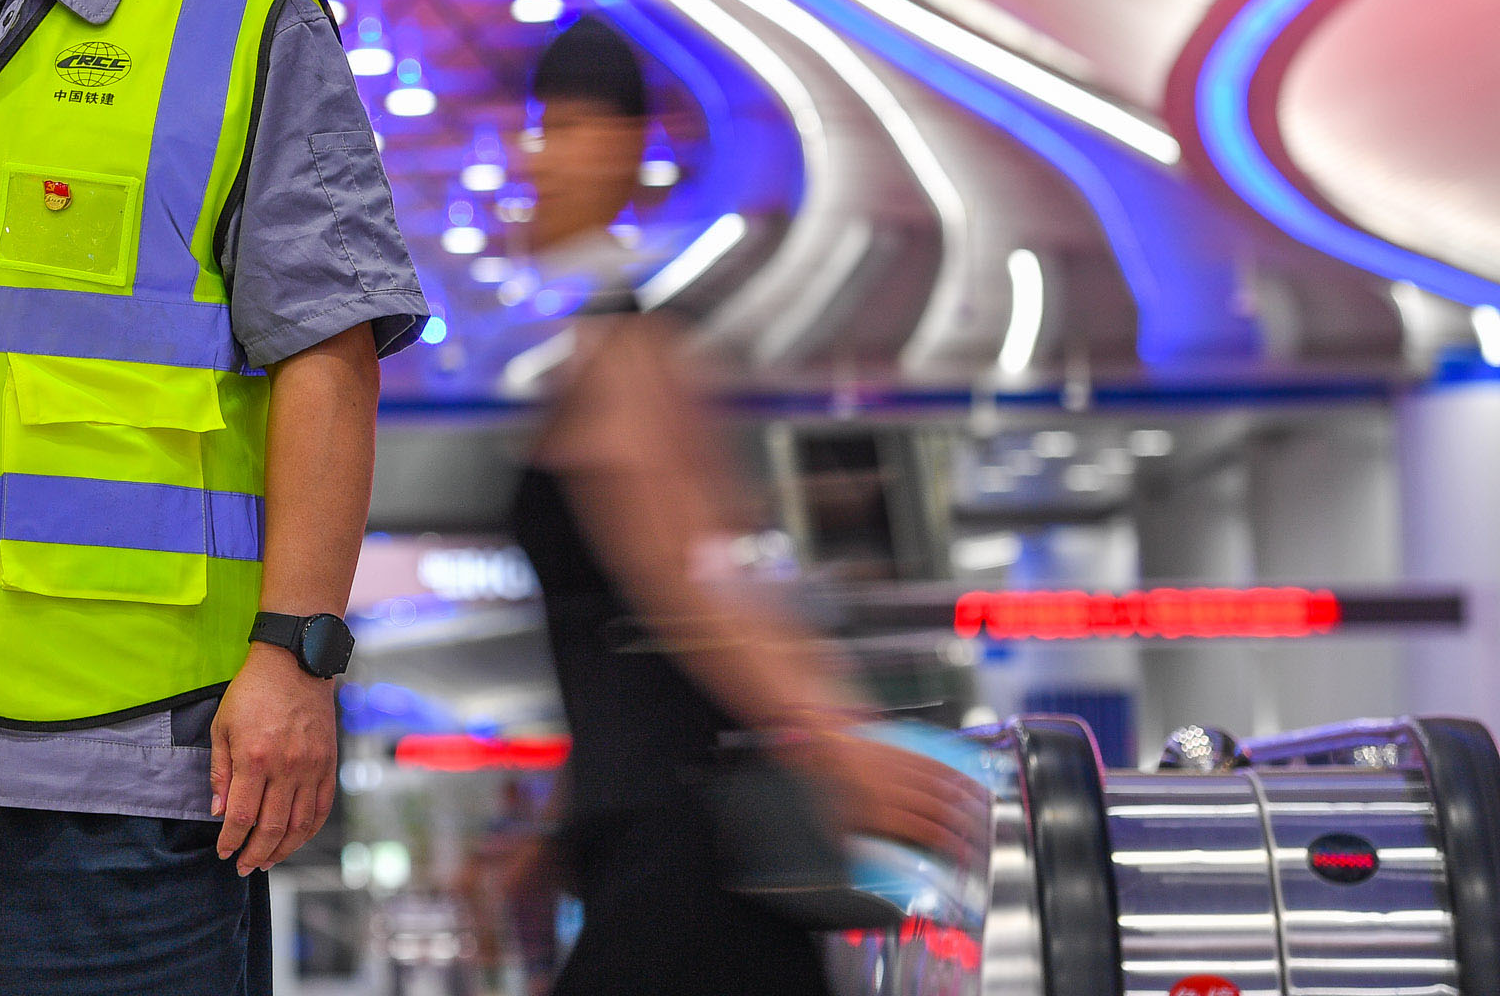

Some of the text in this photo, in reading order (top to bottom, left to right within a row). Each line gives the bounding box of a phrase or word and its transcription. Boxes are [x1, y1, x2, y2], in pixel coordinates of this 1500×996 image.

[57, 54, 130, 72] CRCC
[53, 89, 115, 106] 中国铁建
